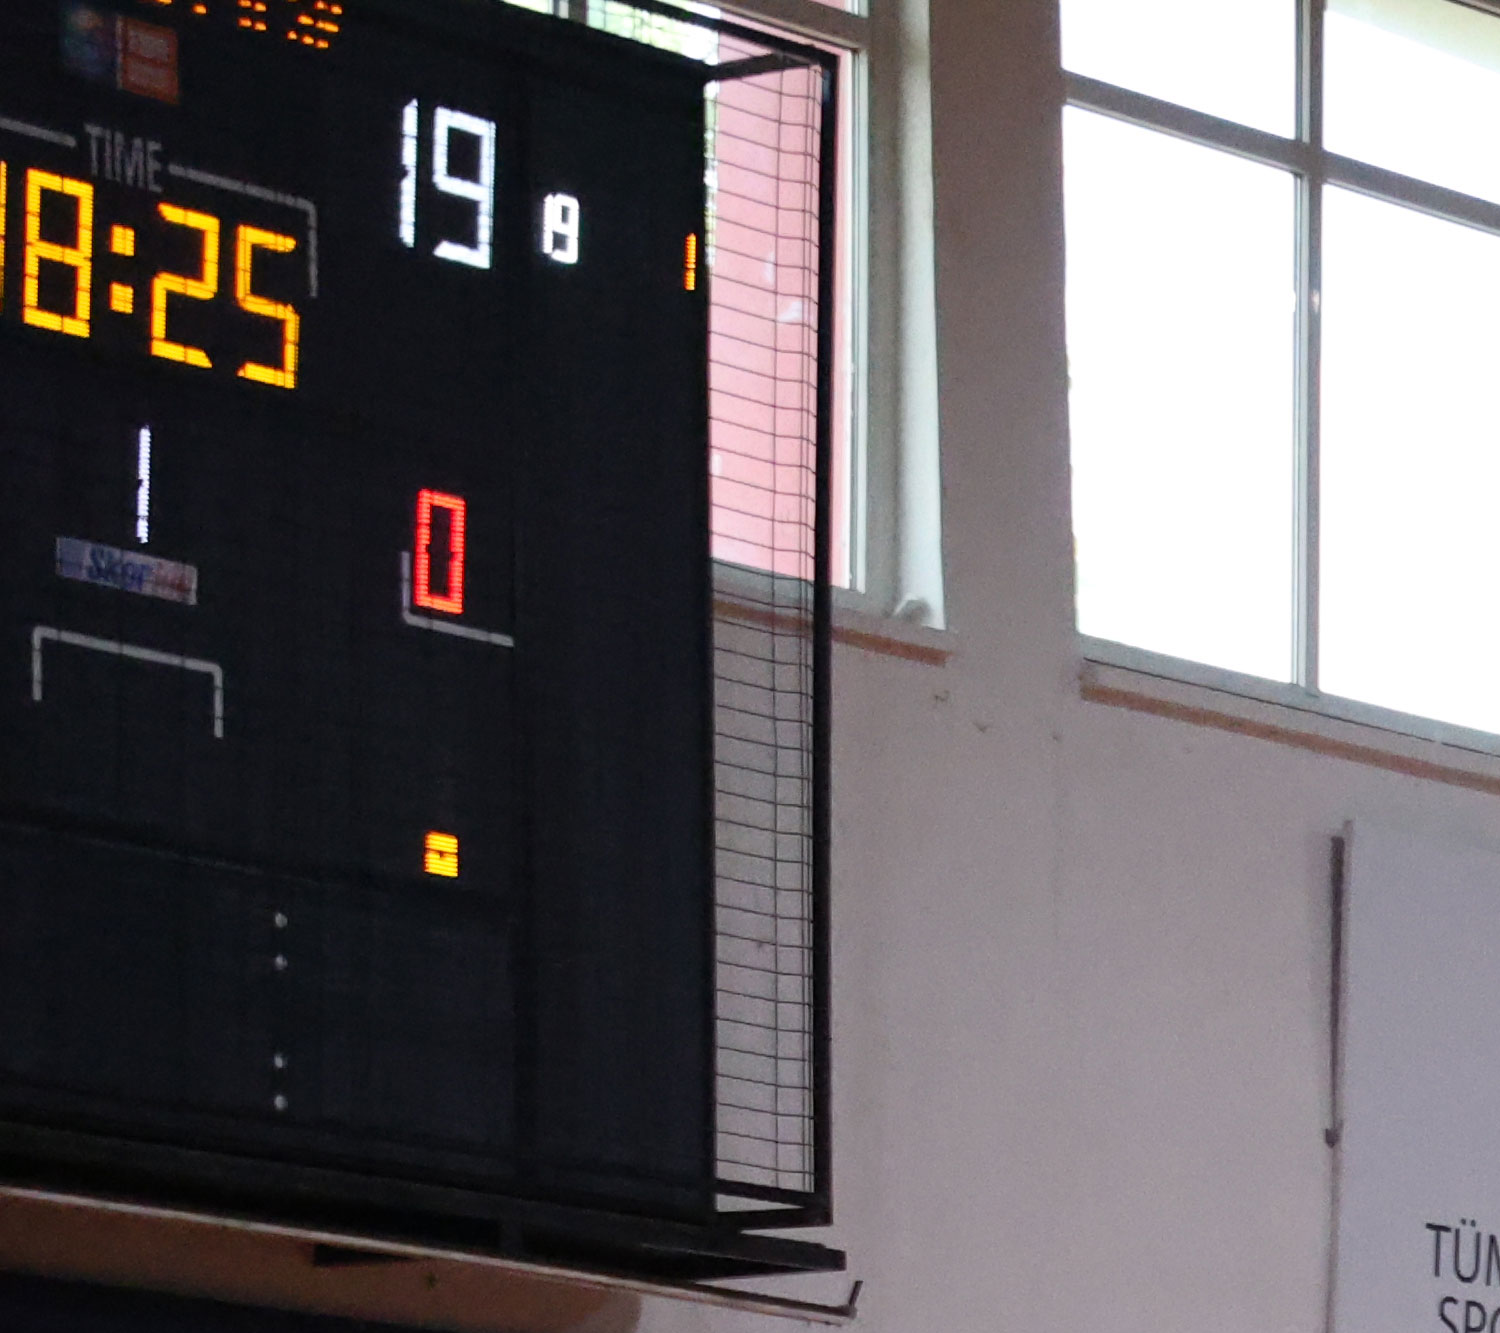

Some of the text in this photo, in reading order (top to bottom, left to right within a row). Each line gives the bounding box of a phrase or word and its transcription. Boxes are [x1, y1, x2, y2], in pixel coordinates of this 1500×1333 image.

[84, 122, 163, 194] TIME
[401, 98, 496, 269] 19
[416, 489, 466, 613] 0
